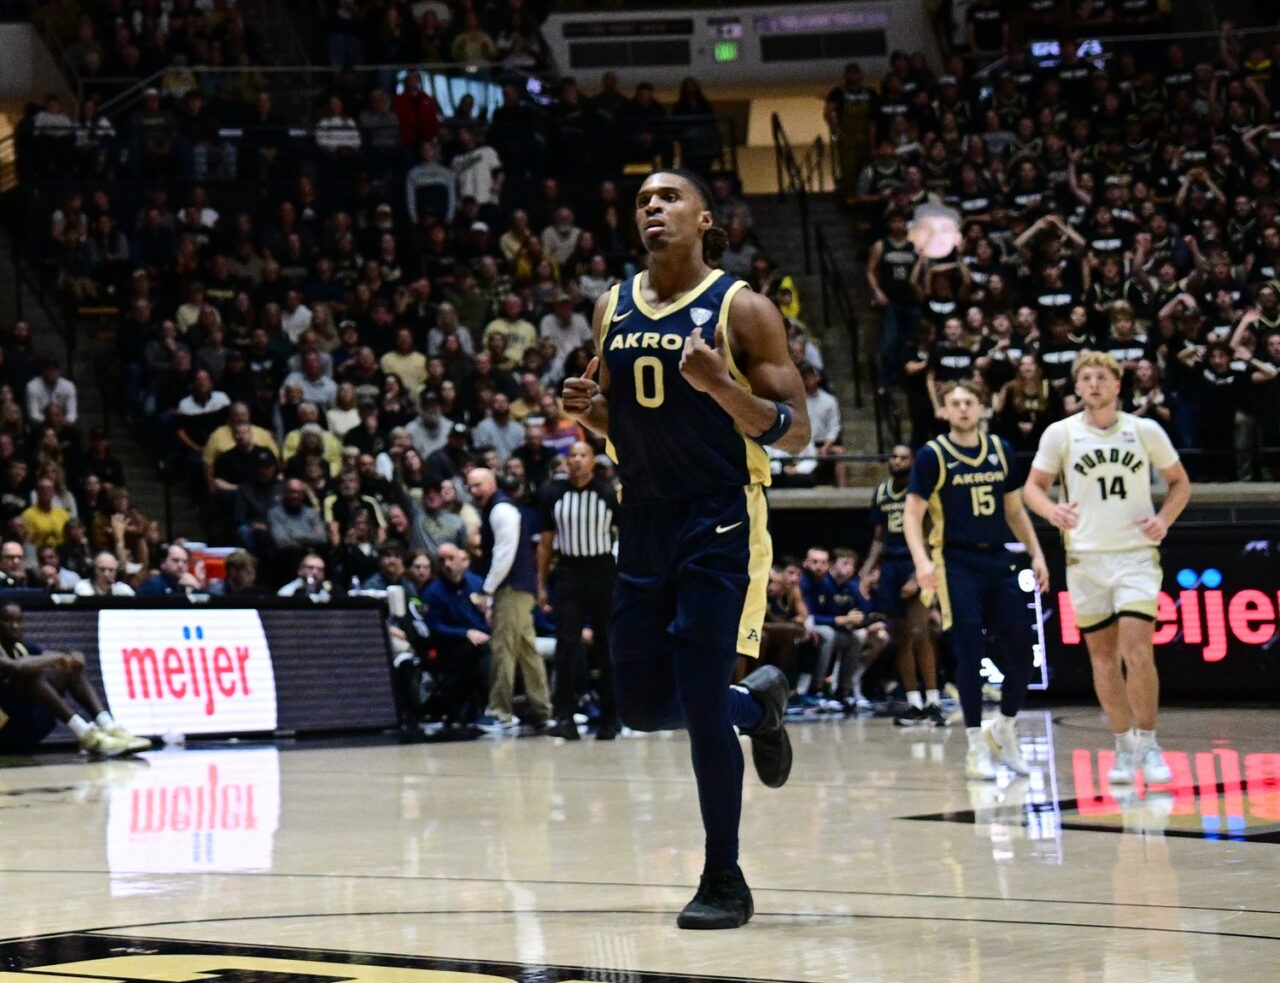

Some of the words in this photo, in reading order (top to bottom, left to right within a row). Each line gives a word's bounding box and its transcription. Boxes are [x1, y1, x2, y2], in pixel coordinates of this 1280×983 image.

[633, 355, 666, 409] 0
[951, 470, 1005, 486] AKRON
[1074, 448, 1144, 476] PURDUE
[970, 484, 996, 517] 15
[1097, 476, 1127, 501] 14
[1058, 568, 1280, 662] eije
[121, 626, 249, 716] meijer
